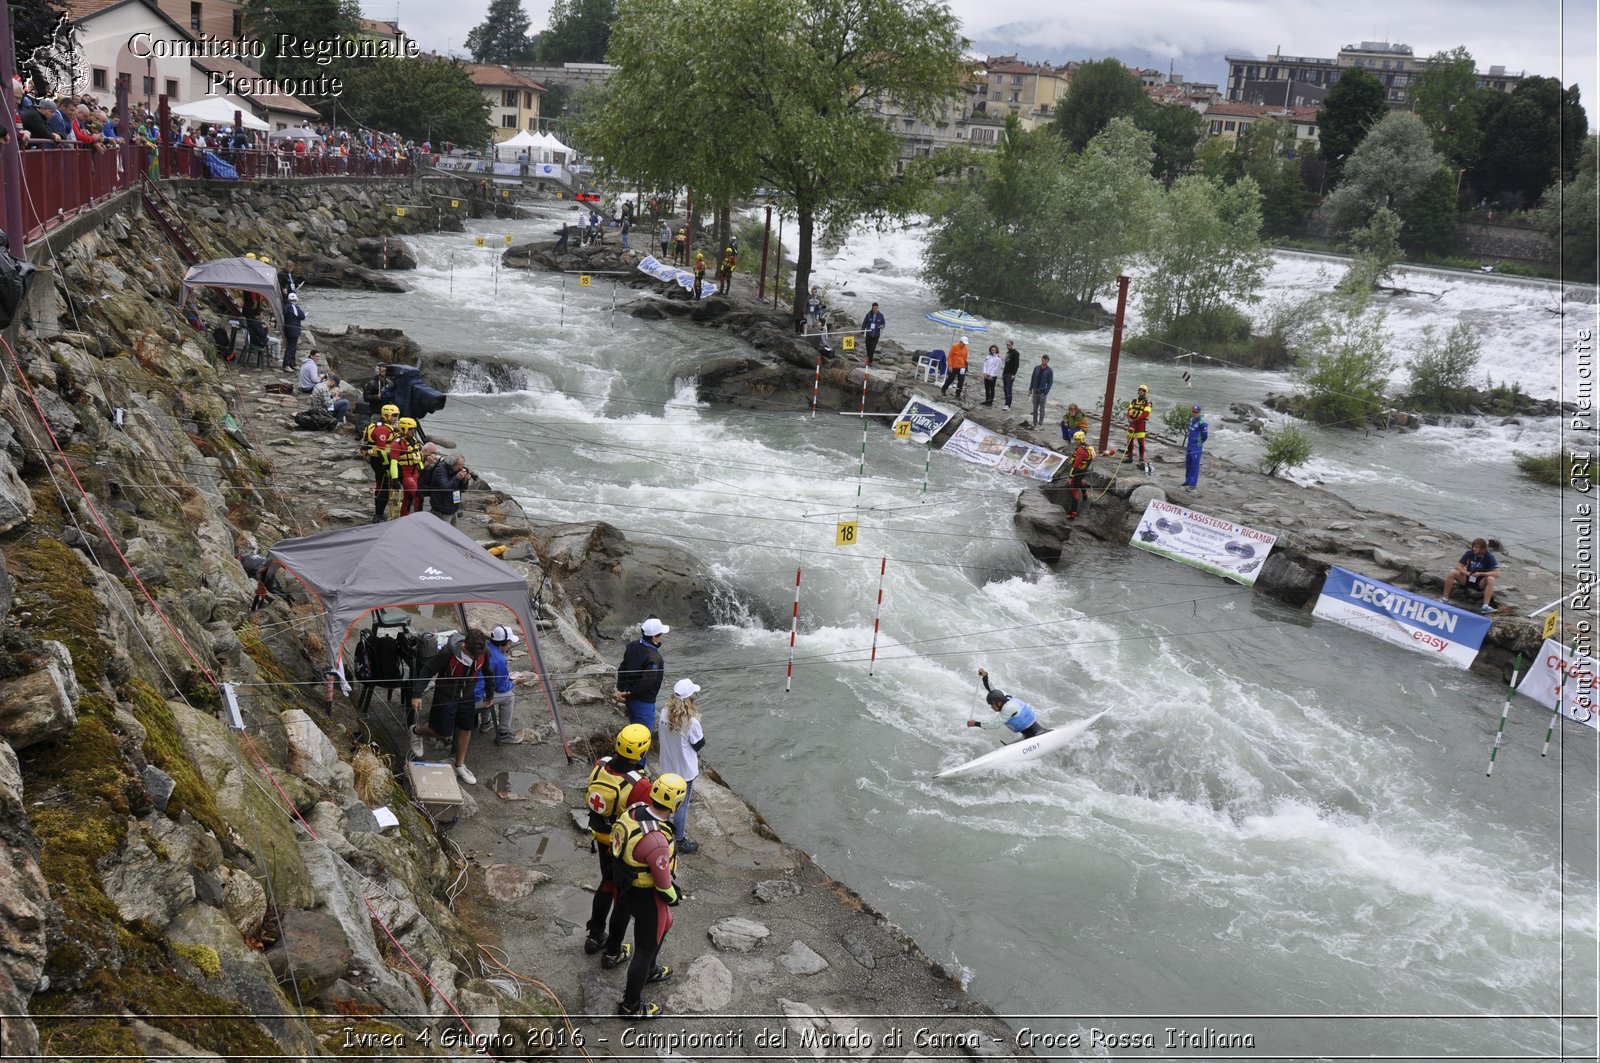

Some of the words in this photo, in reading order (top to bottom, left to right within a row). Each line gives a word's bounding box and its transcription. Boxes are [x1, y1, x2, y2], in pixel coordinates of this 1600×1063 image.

[845, 338, 853, 347] 16
[898, 424, 909, 436] 17
[1152, 500, 1183, 517] VENDITA
[1188, 512, 1234, 532] ASSISTENZA
[1241, 528, 1275, 545] RICAMBI
[840, 525, 854, 541] 18
[1350, 579, 1459, 634] DECATHLON
[1413, 628, 1449, 653] easy
[1022, 744, 1037, 754] CHEN
